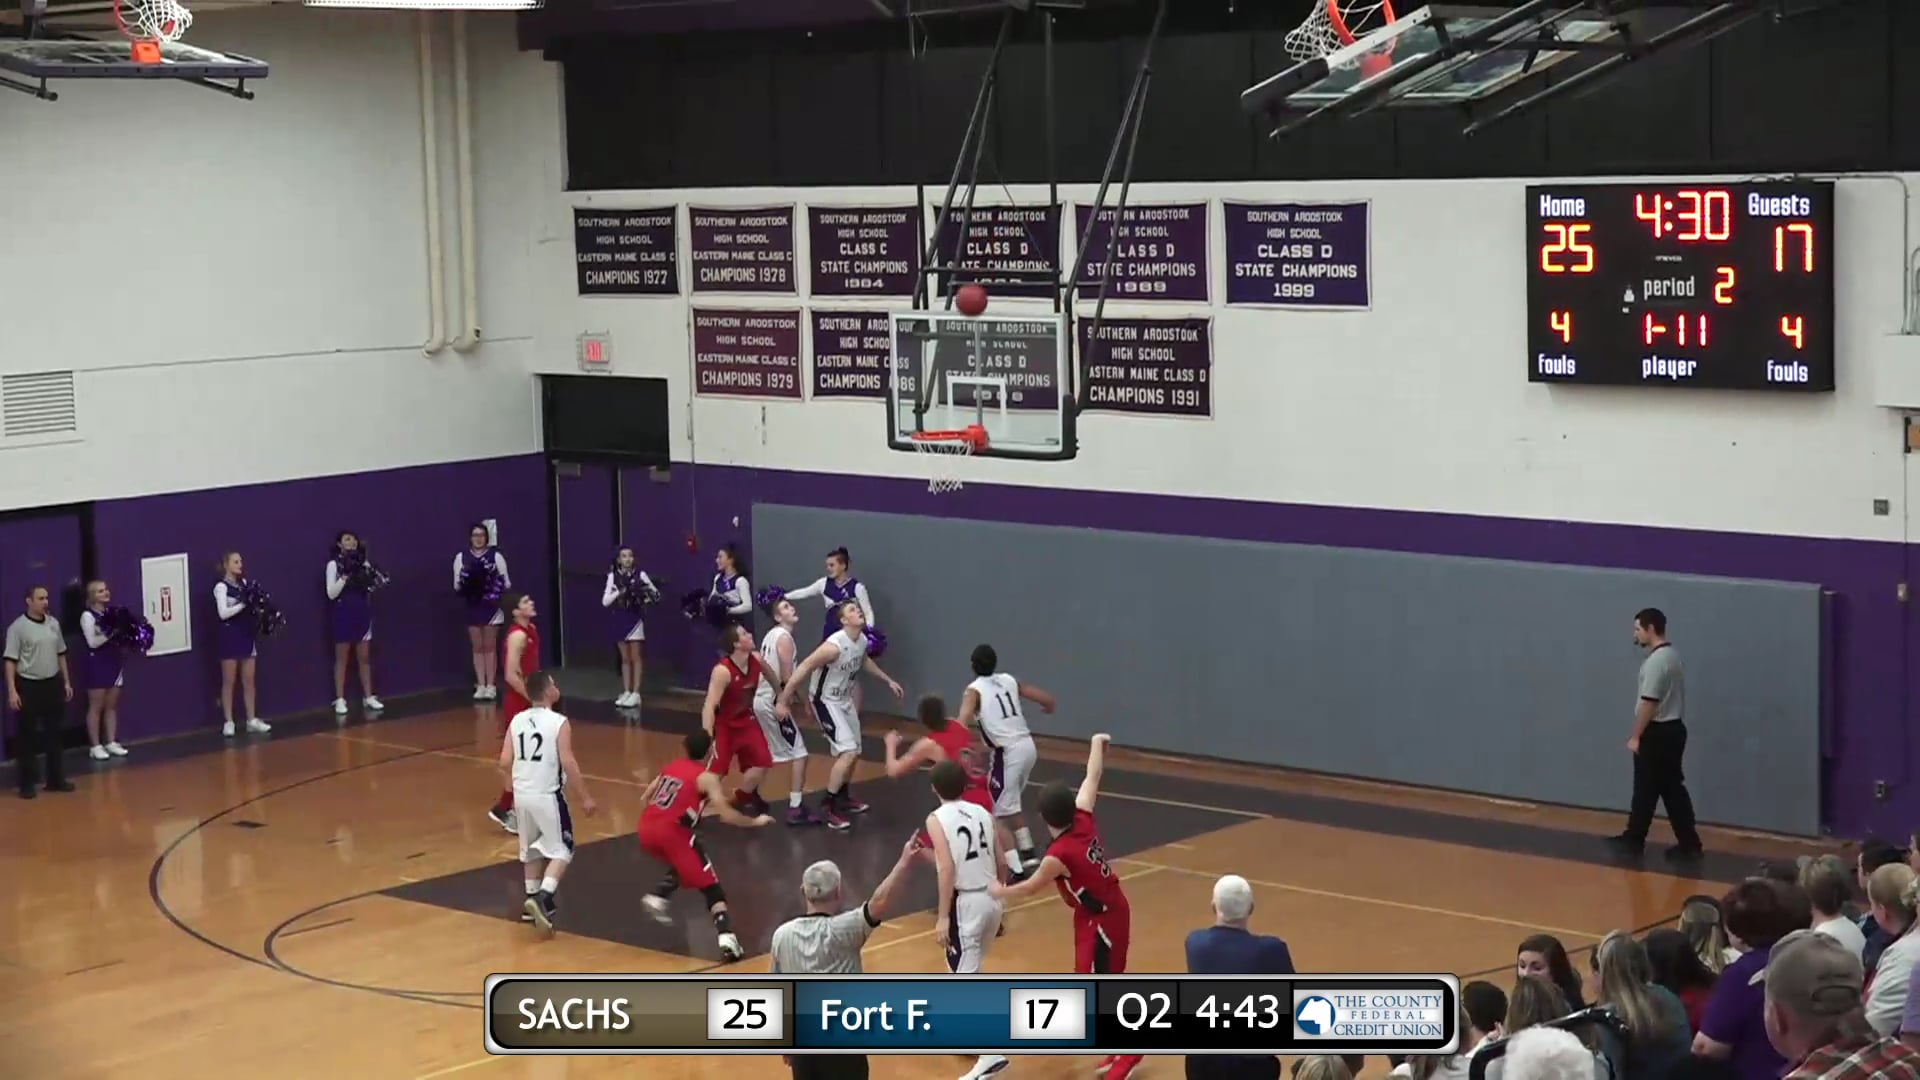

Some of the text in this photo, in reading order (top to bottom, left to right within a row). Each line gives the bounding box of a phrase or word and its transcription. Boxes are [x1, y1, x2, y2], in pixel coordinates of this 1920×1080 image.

[1540, 194, 1585, 216] Home
[1748, 192, 1811, 217] Guests
[578, 216, 672, 227] SOUTHERN AROOSTOOK
[695, 216, 788, 227] SOUTHERN AROOSTOOK
[820, 213, 907, 224] SOUTHERN AROOSTOOK
[998, 211, 1046, 222] AROOSTOOK
[1139, 209, 1190, 221] AROOSTOOK
[1247, 211, 1343, 222] SOUTHERN AROOSTOOK
[1635, 190, 1730, 241] 4:30
[837, 228, 889, 239] HIGH SCHOOL
[969, 227, 1025, 237] HIGH SCHOOL
[1135, 226, 1169, 237] SCHOOL
[1267, 228, 1322, 239] HIGH SCHOOL
[596, 235, 653, 245] HIGH SCHOOL
[713, 234, 769, 244] HIGH SCHOOL
[840, 243, 888, 256] CLASS C
[967, 243, 1029, 255] CLASS D
[1107, 243, 1175, 258] LASS D
[1258, 244, 1333, 258] CLASS D
[1541, 223, 1594, 272] 25
[1775, 222, 1814, 273] 17
[578, 252, 675, 262] EASTERN MAINE CLASS C
[693, 251, 793, 261] EASTERN MAINE CLASS C
[700, 267, 786, 283] CHAMPIONS 1978
[820, 261, 908, 275] STATE CHAMPIONS
[1129, 263, 1197, 277] CHAMPIONS
[1235, 264, 1358, 279] STATE CHAMPIONS
[586, 270, 668, 285] CHAMPIONS 1977
[1273, 283, 1315, 297] 1999
[1643, 266, 1735, 304] period 2
[697, 317, 797, 329] SOUTHERN AROOSTOOK
[819, 318, 862, 330] SOUTHERN
[1550, 311, 1571, 343] 4
[1087, 326, 1199, 342] SUTHERN AROOSTOOK
[1781, 315, 1803, 349] 4
[716, 335, 776, 347] HIGH SCHOOL
[839, 337, 890, 349] HIGH SCHOO
[698, 353, 797, 366] EASTERN MAINE CLASS C
[1111, 347, 1176, 361] HIGH SCHOOL
[817, 355, 852, 367] EASTERN
[855, 355, 880, 368] MAINE
[968, 355, 1027, 368] CASS D
[1537, 353, 1576, 376] fouls
[1642, 355, 1697, 380] player
[1088, 366, 1206, 382] ASTERN MAINE CLASS D
[1767, 360, 1809, 383] fouls
[702, 370, 794, 389] CHAMPIONS 1979
[819, 373, 881, 389] CHAMPIONS
[1089, 386, 1200, 407] CHAMPIONS 1991
[994, 690, 1019, 719] 11
[517, 731, 544, 762] 12
[956, 821, 989, 861] 24
